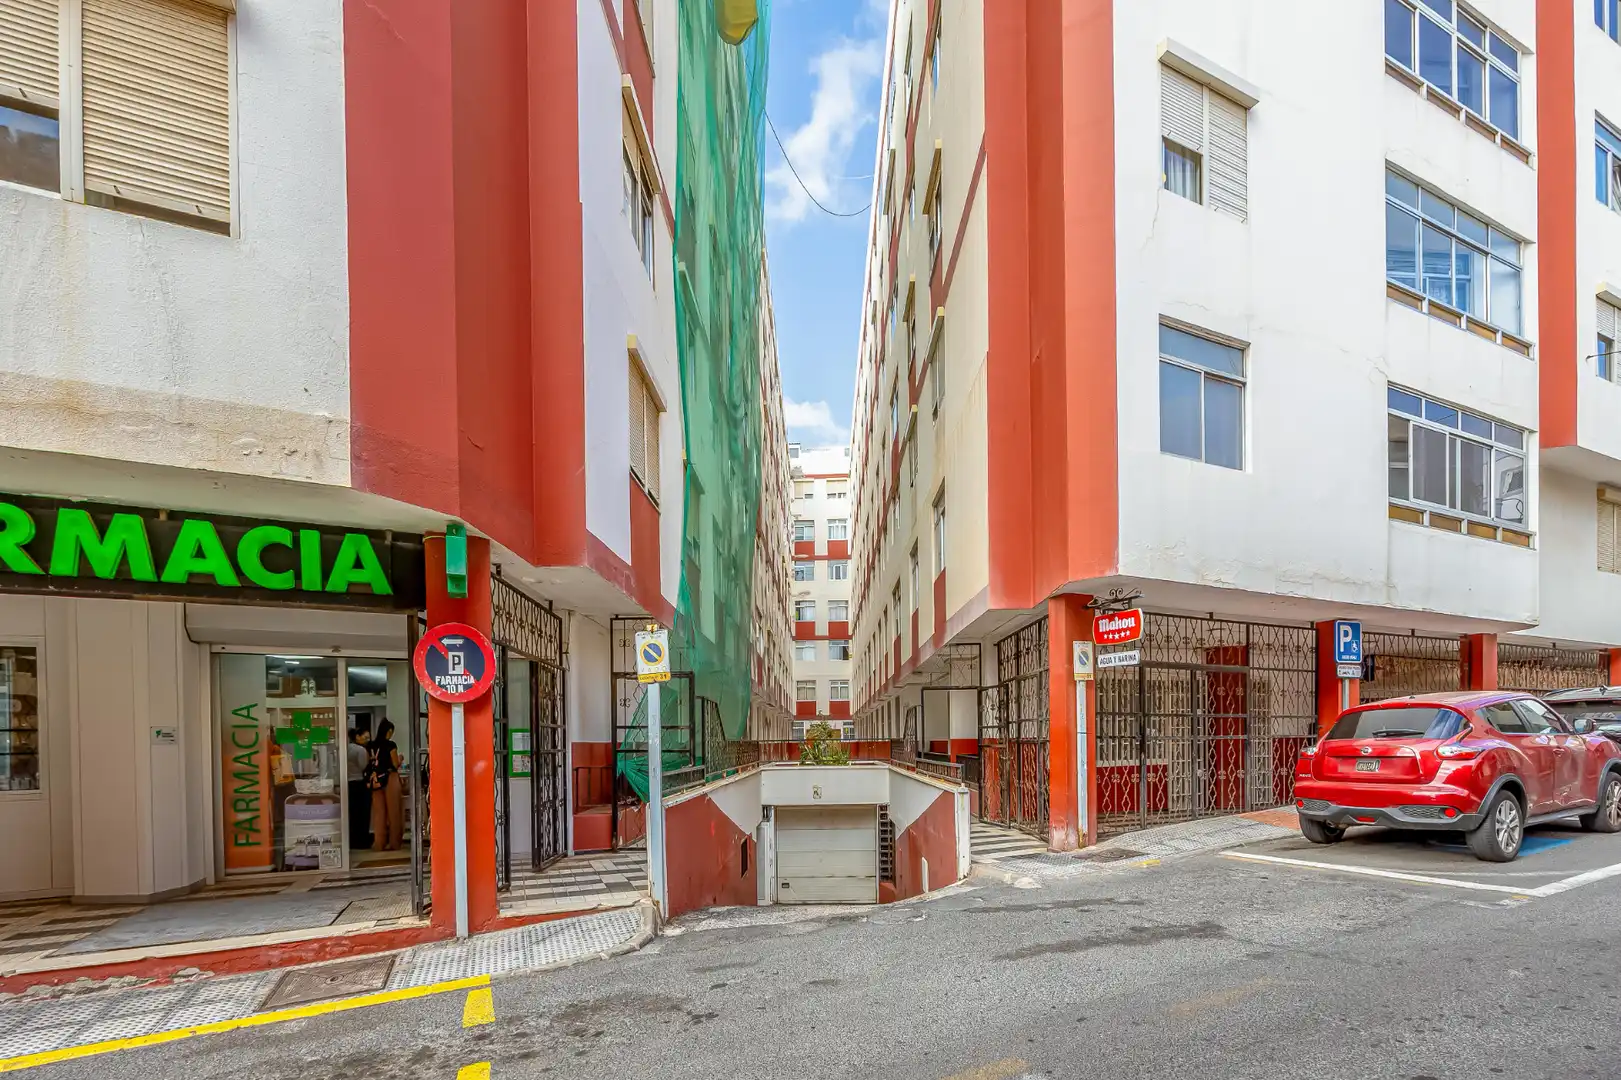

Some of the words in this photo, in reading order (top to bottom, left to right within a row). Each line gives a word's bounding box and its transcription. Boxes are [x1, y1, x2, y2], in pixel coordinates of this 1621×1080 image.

[1098, 616, 1136, 632] Mahou
[1340, 624, 1352, 652] P
[451, 655, 461, 671] P
[1100, 656, 1113, 665] AGUA
[435, 675, 475, 685] FARMACIA
[446, 685, 455, 694] 10
[231, 703, 261, 847] FARMACIA
